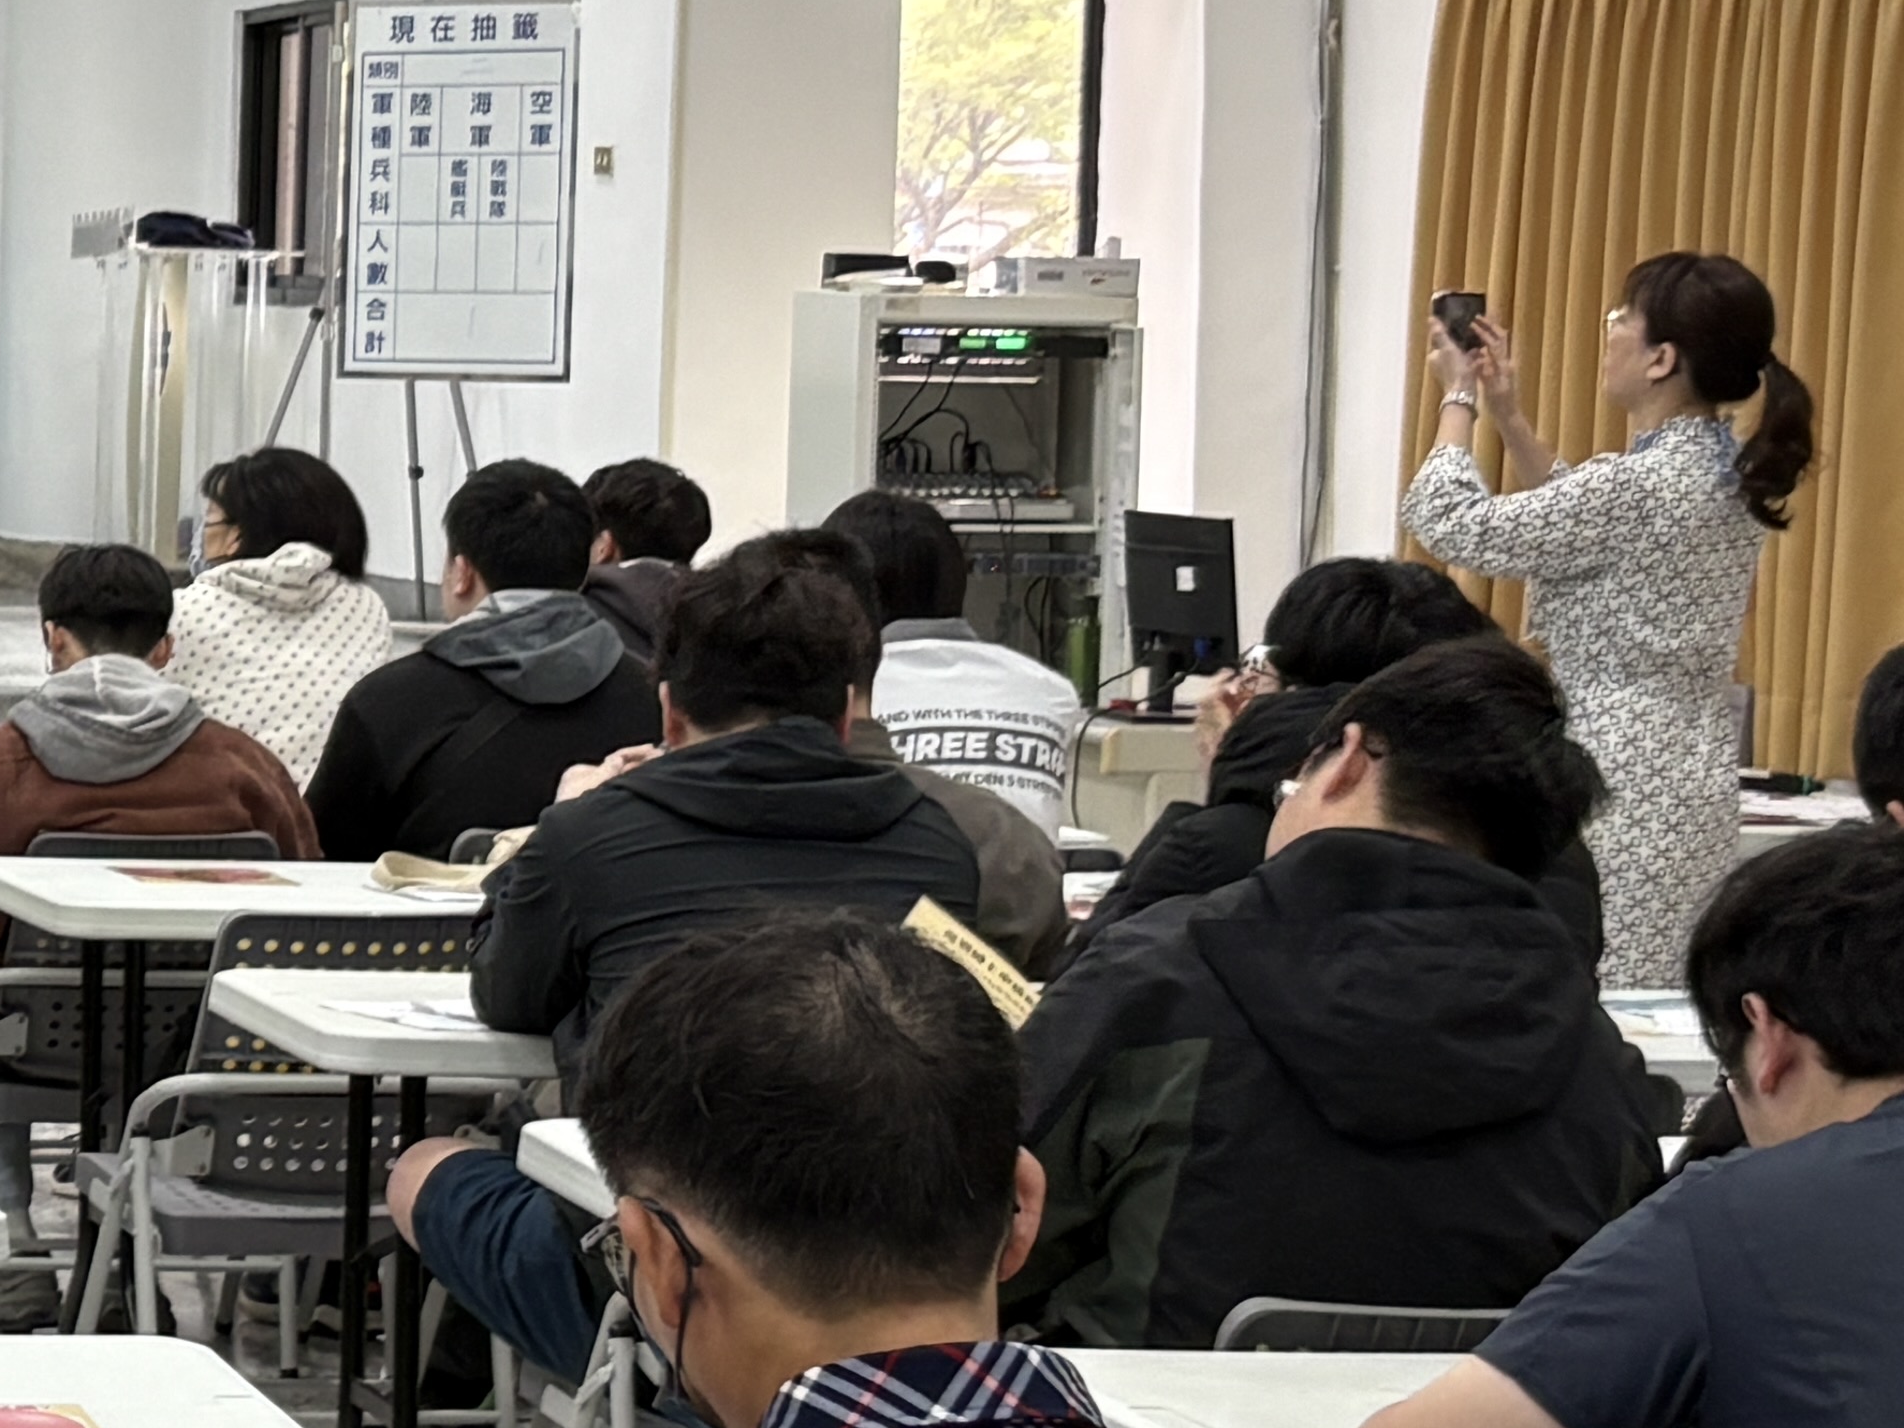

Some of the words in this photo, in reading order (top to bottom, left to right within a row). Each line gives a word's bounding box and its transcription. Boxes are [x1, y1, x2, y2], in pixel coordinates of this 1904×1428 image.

[389, 13, 540, 44] 現在抽籤
[409, 92, 433, 148] 陸軍
[469, 91, 493, 148] 海軍
[530, 90, 554, 148] 空軍
[368, 92, 394, 216] 軍種兵科
[366, 230, 389, 286] 人數
[364, 297, 387, 355] 合計
